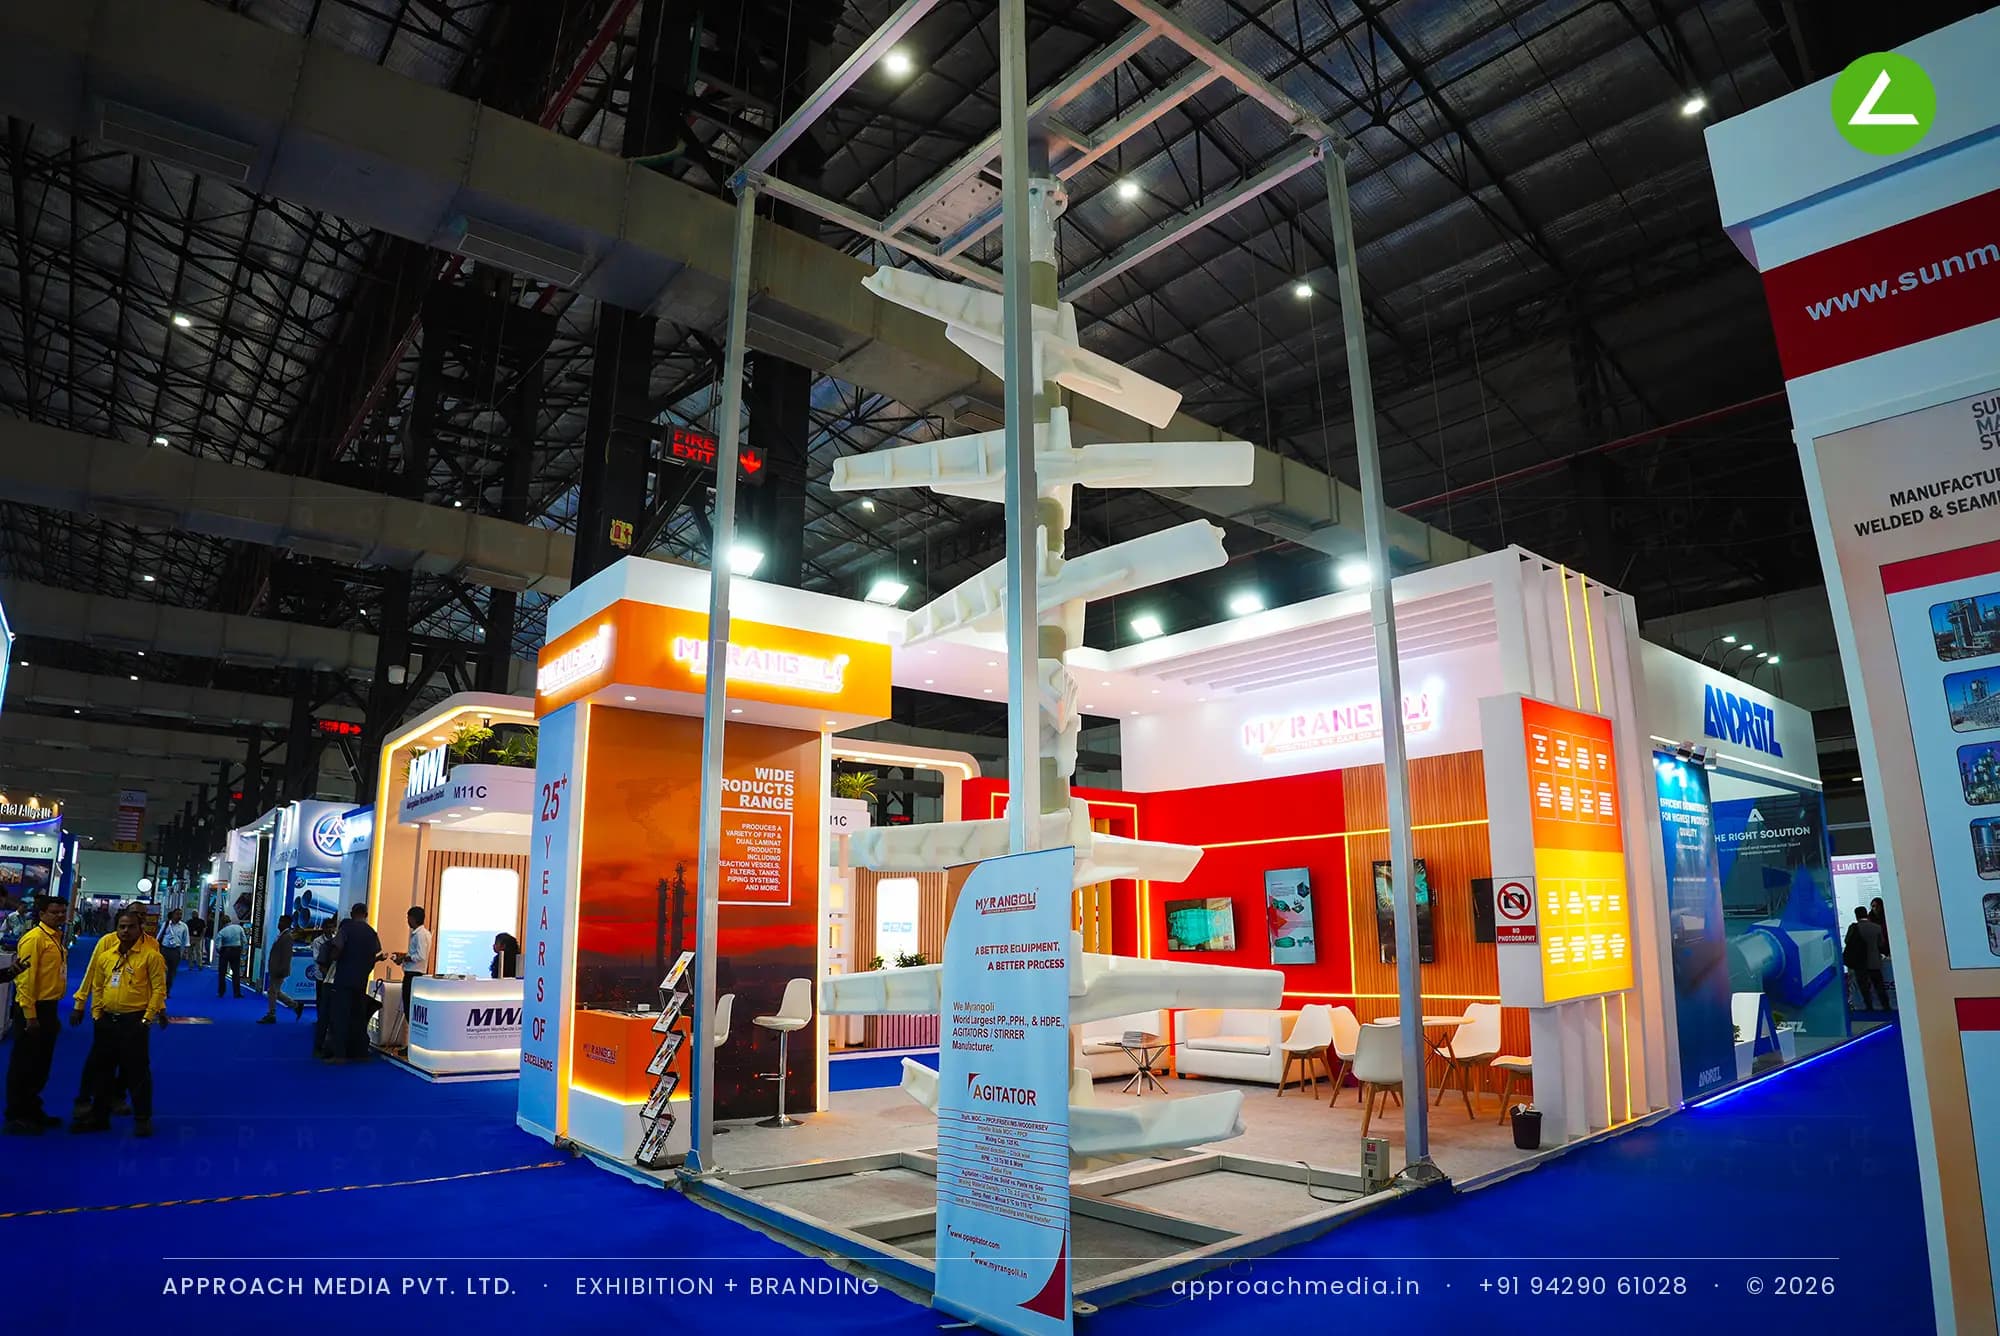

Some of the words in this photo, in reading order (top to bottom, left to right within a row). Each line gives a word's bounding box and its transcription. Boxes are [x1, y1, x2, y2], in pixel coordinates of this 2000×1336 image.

[1972, 396, 2000, 419] SU
[673, 429, 715, 450] FIRE
[672, 443, 716, 464] EXIT
[1854, 509, 1925, 537] WELDED
[1928, 504, 1944, 520] &
[1946, 491, 2000, 516] SEAM
[1703, 684, 1784, 758] ANDRITZ
[407, 743, 448, 798] MWL
[755, 767, 794, 783] WIDE
[453, 785, 488, 799] M11C
[720, 778, 794, 797] RODUCTS
[740, 794, 793, 810] RANGE
[726, 830, 753, 838] VARIETY
[741, 823, 777, 832] PRODUCES
[1714, 830, 1727, 843] HE
[1728, 831, 1758, 842] RIGHT
[1760, 826, 1811, 839] SOLUTION
[736, 838, 753, 846] DUAL
[747, 846, 782, 854] PRODUCTS
[752, 861, 781, 869] VESSELS,
[1836, 861, 1874, 872] LIMITED
[727, 875, 749, 883] PIPING
[749, 876, 781, 884] SYSTEMS,
[1498, 934, 1535, 942] PHOTOGRAPHY
[975, 946, 980, 955] A
[980, 944, 1009, 955] BETTER
[987, 961, 994, 971] A
[996, 960, 1025, 971] BETTER
[1027, 959, 1065, 970] PROCESS
[953, 1002, 964, 1011] We
[413, 1004, 429, 1026] MWL
[466, 1007, 522, 1026] MW
[952, 1016, 971, 1025] World
[971, 1016, 996, 1027] Largest
[1031, 1016, 1038, 1026] &
[532, 1017, 546, 1042] OF
[952, 1028, 989, 1039] AGITATORS
[994, 1029, 1025, 1040] STIRRER
[524, 1052, 553, 1072] EXCELLENCE
[973, 1084, 1037, 1106] AGITATOR
